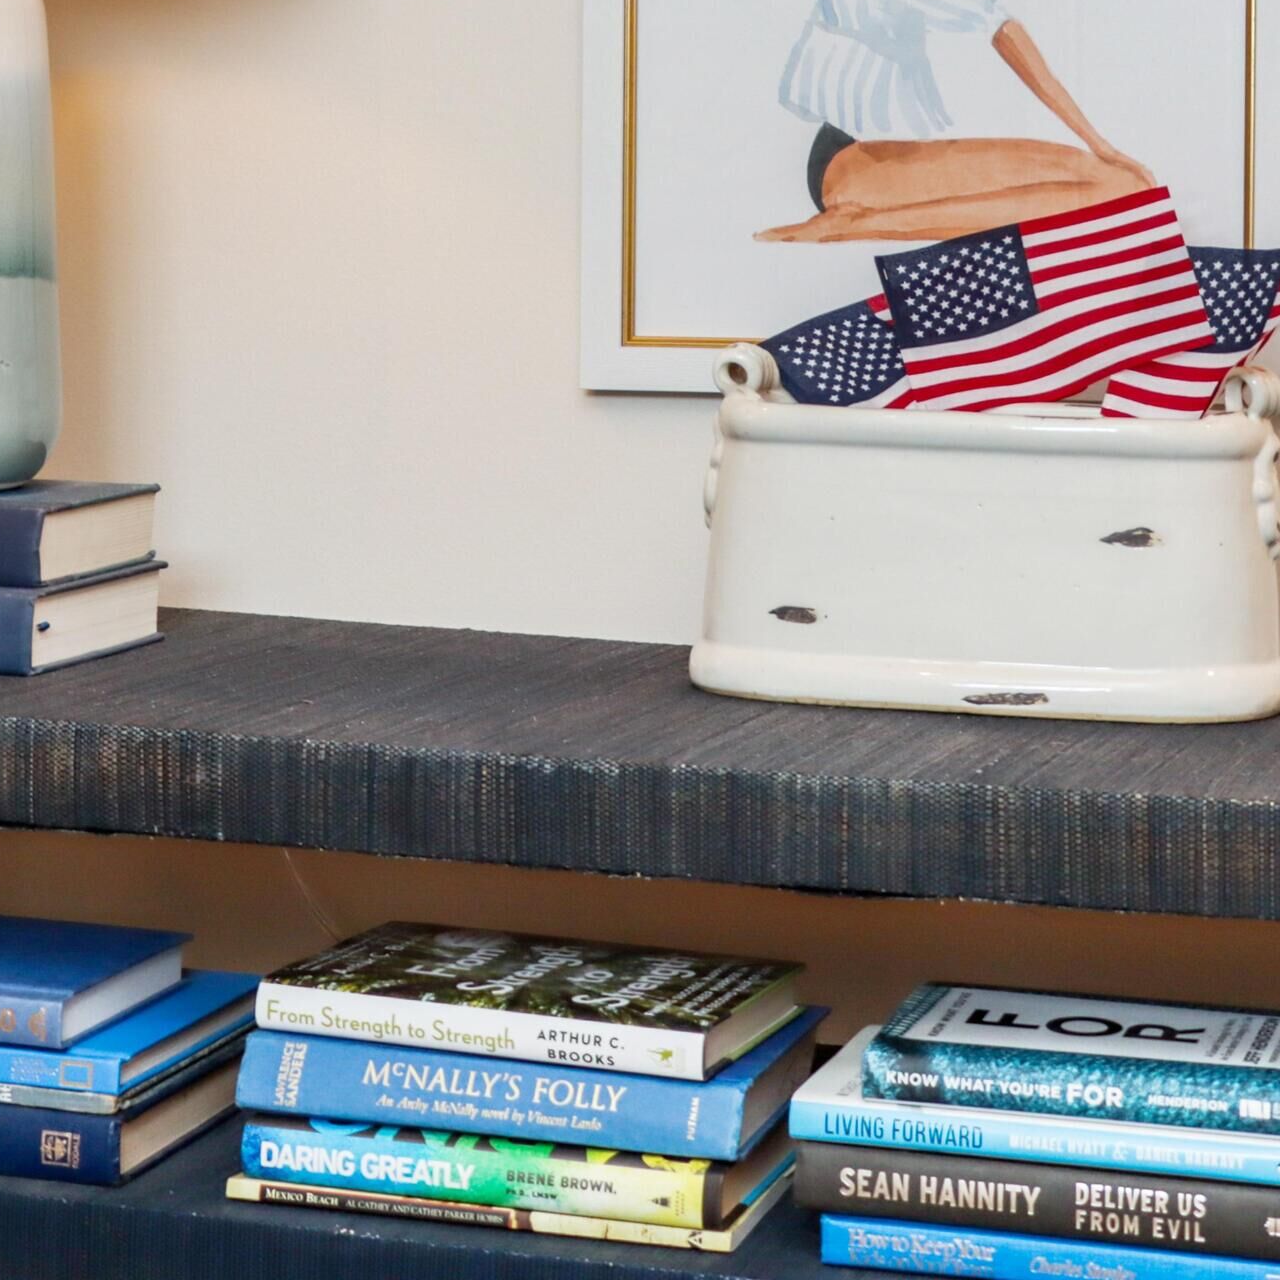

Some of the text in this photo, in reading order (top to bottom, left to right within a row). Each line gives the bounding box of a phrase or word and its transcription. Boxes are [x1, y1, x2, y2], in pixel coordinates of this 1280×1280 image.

[404, 947, 506, 979] From
[567, 968, 615, 987] to
[266, 999, 516, 1053] From Strength to Strength
[536, 1029, 625, 1050] ARTHUR C.
[966, 1008, 1206, 1044] FOR
[272, 1041, 294, 1107] LAWRENCE
[285, 1043, 308, 1108] SANDERS
[547, 1048, 616, 1067] BROOKS
[532, 1077, 628, 1113] FOLLY
[886, 1070, 939, 1089] KNOW
[943, 1075, 995, 1093] WHAT
[998, 1081, 1062, 1100] YOU'RE
[1066, 1083, 1124, 1108] FOR
[1147, 1094, 1228, 1112] HENDERSON
[376, 1094, 394, 1107] An
[432, 1100, 479, 1120] McNally
[481, 1106, 510, 1121] novel
[511, 1109, 526, 1124] by
[527, 1111, 568, 1127] Vincent
[686, 1096, 700, 1141] PUTNAM
[824, 1111, 884, 1140] LIVING
[892, 1119, 983, 1150] FORWARD
[1008, 1134, 1063, 1152] MICHAEL
[1112, 1141, 1129, 1161] &
[260, 1141, 476, 1191] DARING GREATLY
[265, 1188, 304, 1203] MEXICO
[306, 1192, 339, 1208] BEACH
[357, 1200, 390, 1213] CATHEY
[392, 1203, 410, 1214] AND
[410, 1205, 444, 1218] CATHEY
[444, 1208, 476, 1221] PARKER
[839, 1167, 1042, 1216] SEAN HANNITY
[1075, 1182, 1207, 1218] DELIVER US
[848, 1227, 888, 1249] How
[888, 1234, 910, 1252] to
[910, 1234, 956, 1261] Keep
[954, 1237, 997, 1262] Your
[1075, 1210, 1207, 1244] FROM EVIL
[1029, 1255, 1083, 1278] Charles
